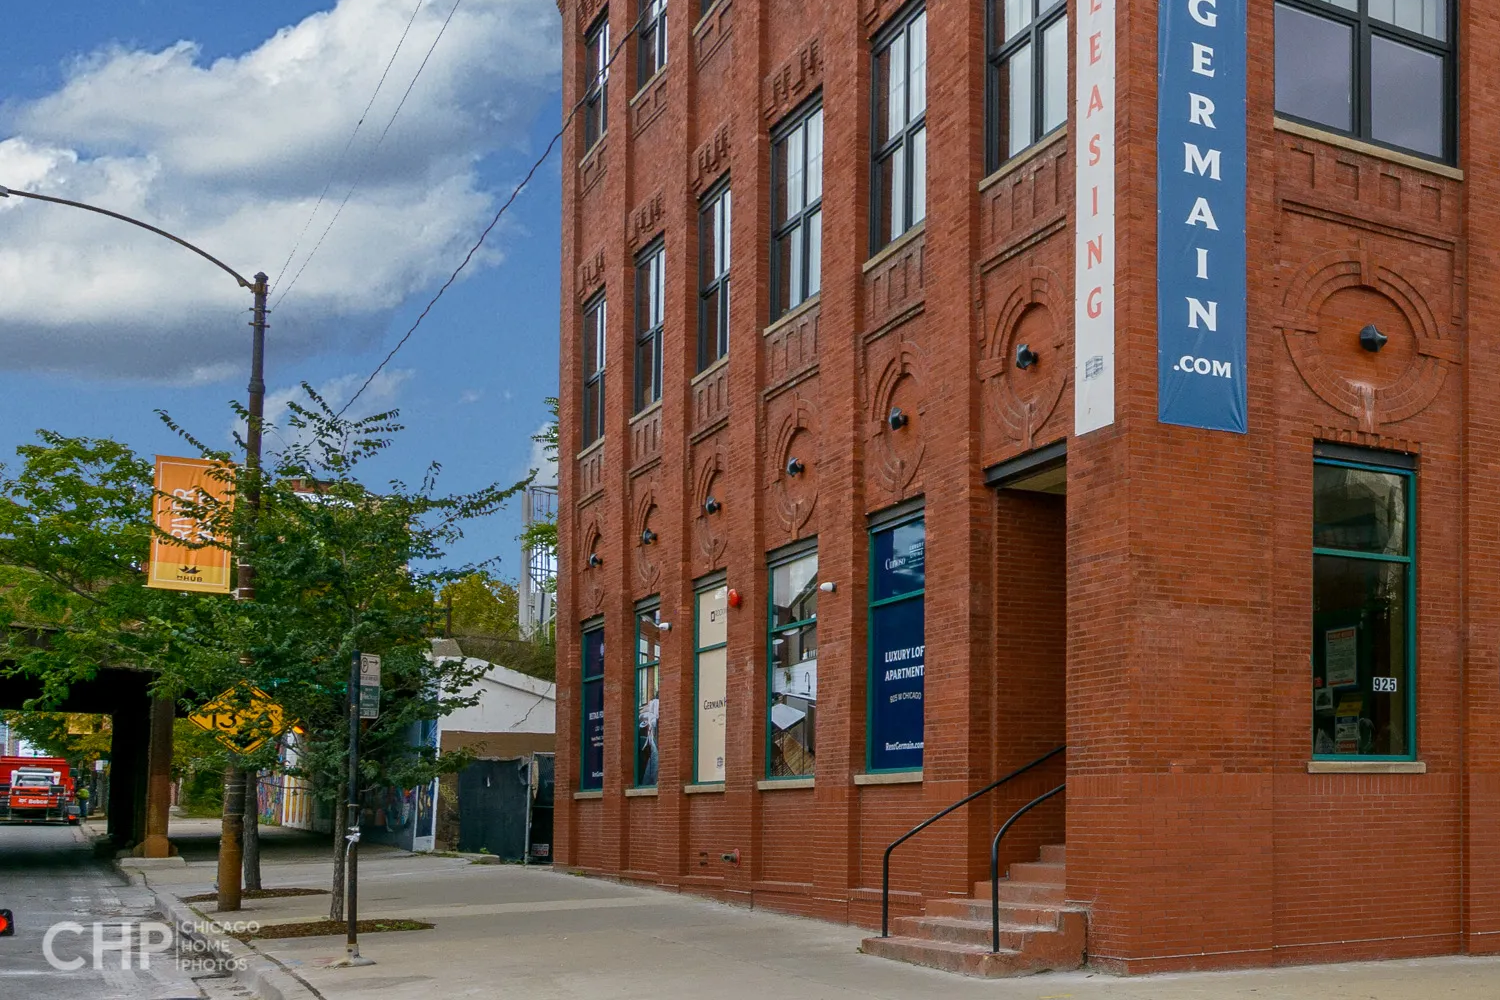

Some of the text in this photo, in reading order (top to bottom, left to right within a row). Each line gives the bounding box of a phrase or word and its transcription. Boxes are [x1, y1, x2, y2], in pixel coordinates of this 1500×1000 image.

[1173, 355, 1232, 379] .COM
[885, 648, 911, 663] LUXURY
[885, 665, 925, 681] APARTMENT
[1374, 677, 1396, 691] 925
[903, 691, 922, 700] CHICAGO
